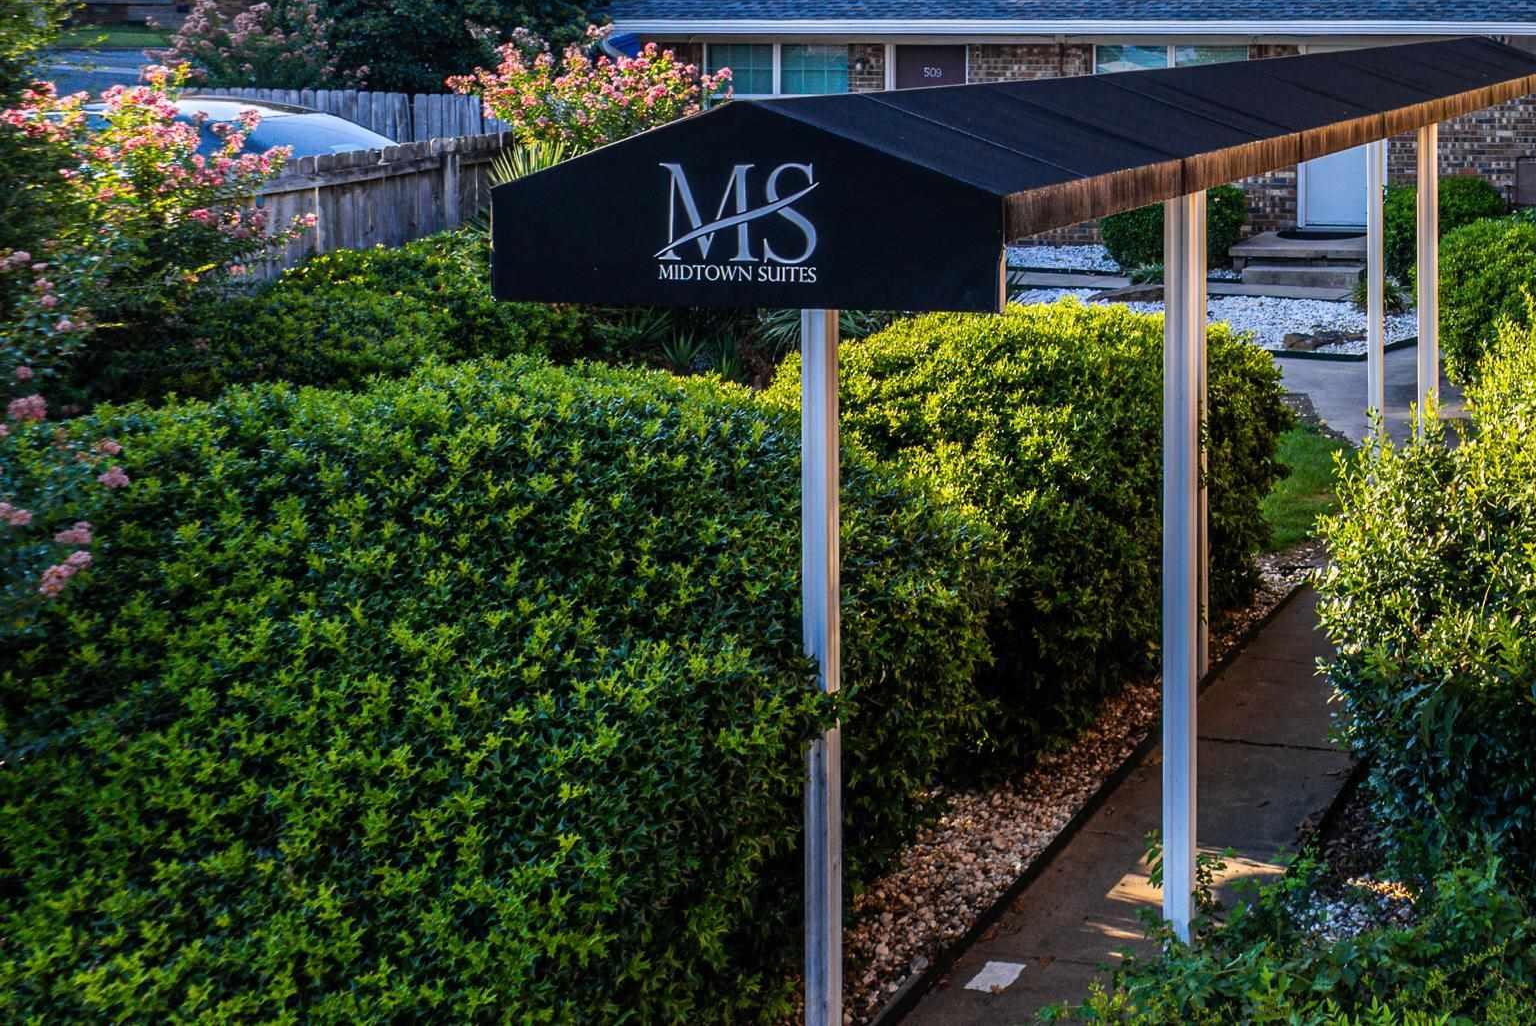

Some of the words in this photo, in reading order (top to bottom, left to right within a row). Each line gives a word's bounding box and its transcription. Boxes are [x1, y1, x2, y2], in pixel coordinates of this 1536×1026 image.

[923, 66, 942, 78] 509
[656, 163, 818, 264] MS
[658, 264, 753, 282] MIDTOWN
[758, 265, 817, 283] SUITES
